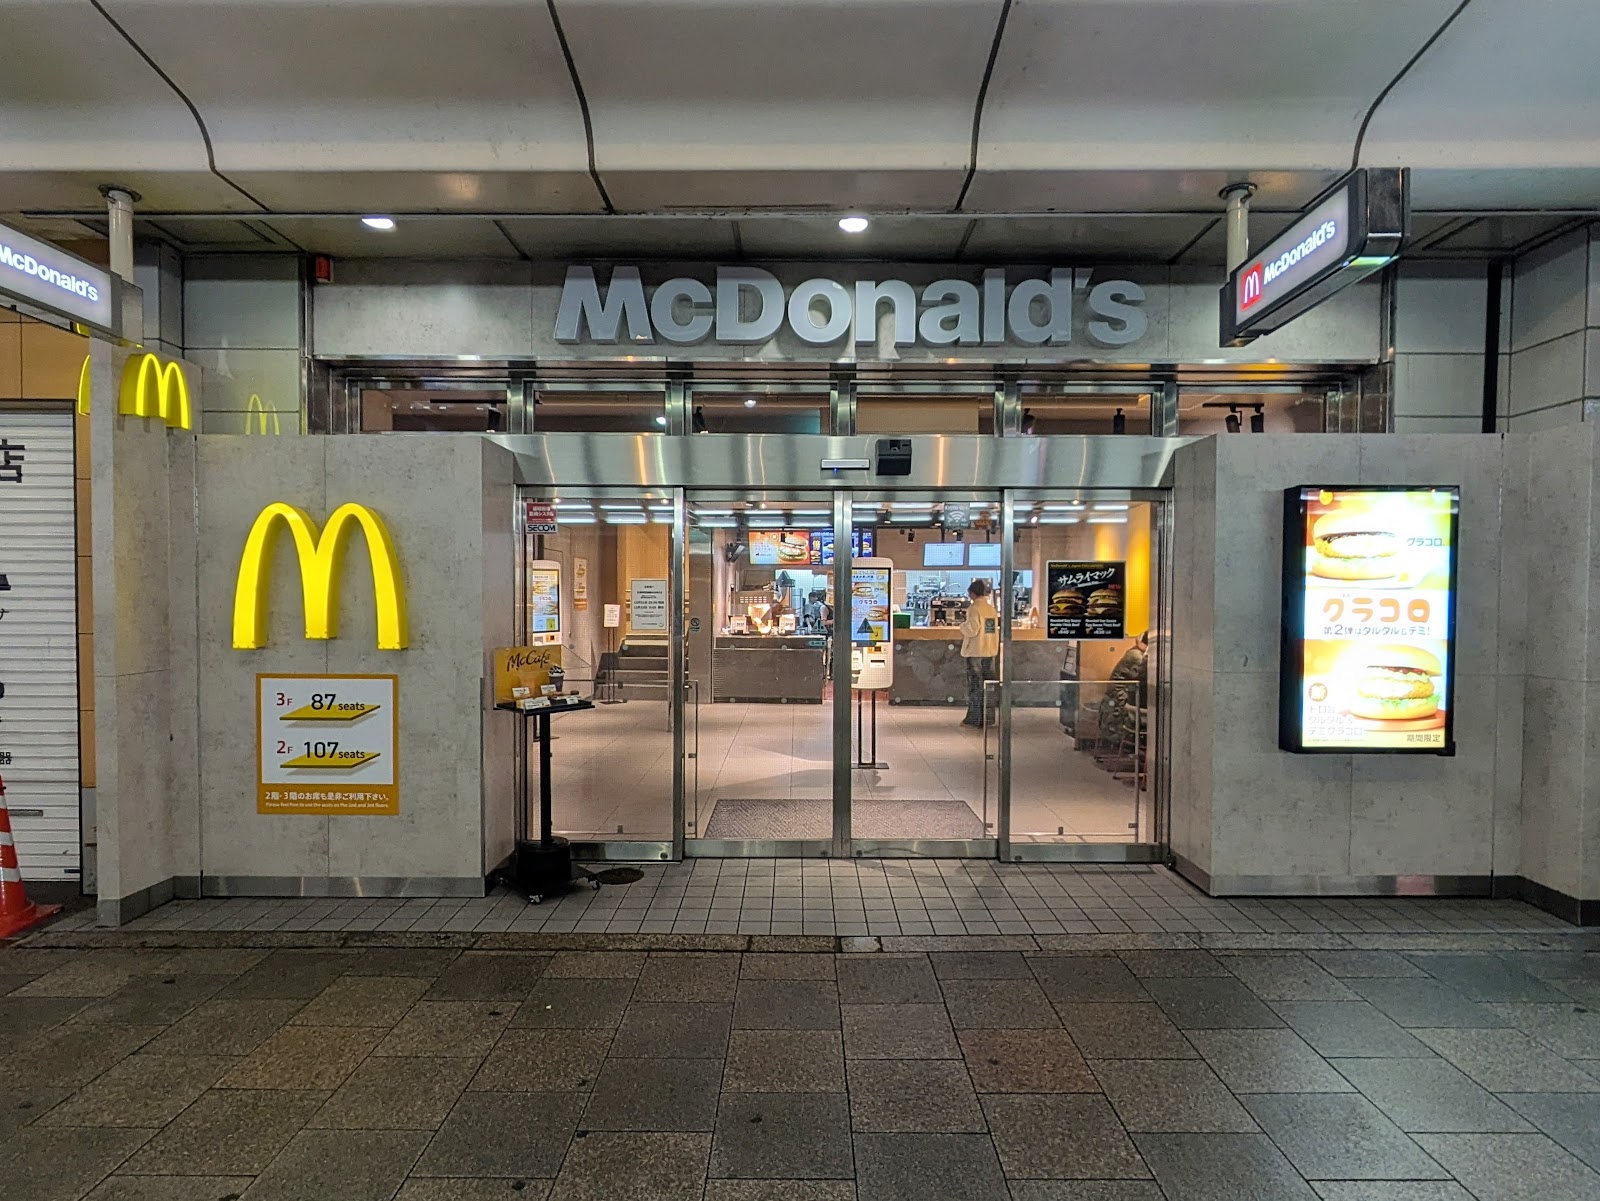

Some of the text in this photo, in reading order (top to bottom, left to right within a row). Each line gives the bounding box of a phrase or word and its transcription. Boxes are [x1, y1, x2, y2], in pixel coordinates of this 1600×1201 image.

[1263, 221, 1336, 285] McDonald's
[0, 244, 98, 301] McDonald's
[554, 265, 1149, 347] McDonald's
[1057, 567, 1116, 587] サムライマック
[1323, 592, 1430, 623] グラコロ
[506, 649, 550, 672] McCafé
[311, 693, 337, 711] 87
[338, 702, 366, 711] seats
[304, 741, 339, 759] 107
[338, 750, 366, 759] seats
[1406, 734, 1441, 743] 期間限定
